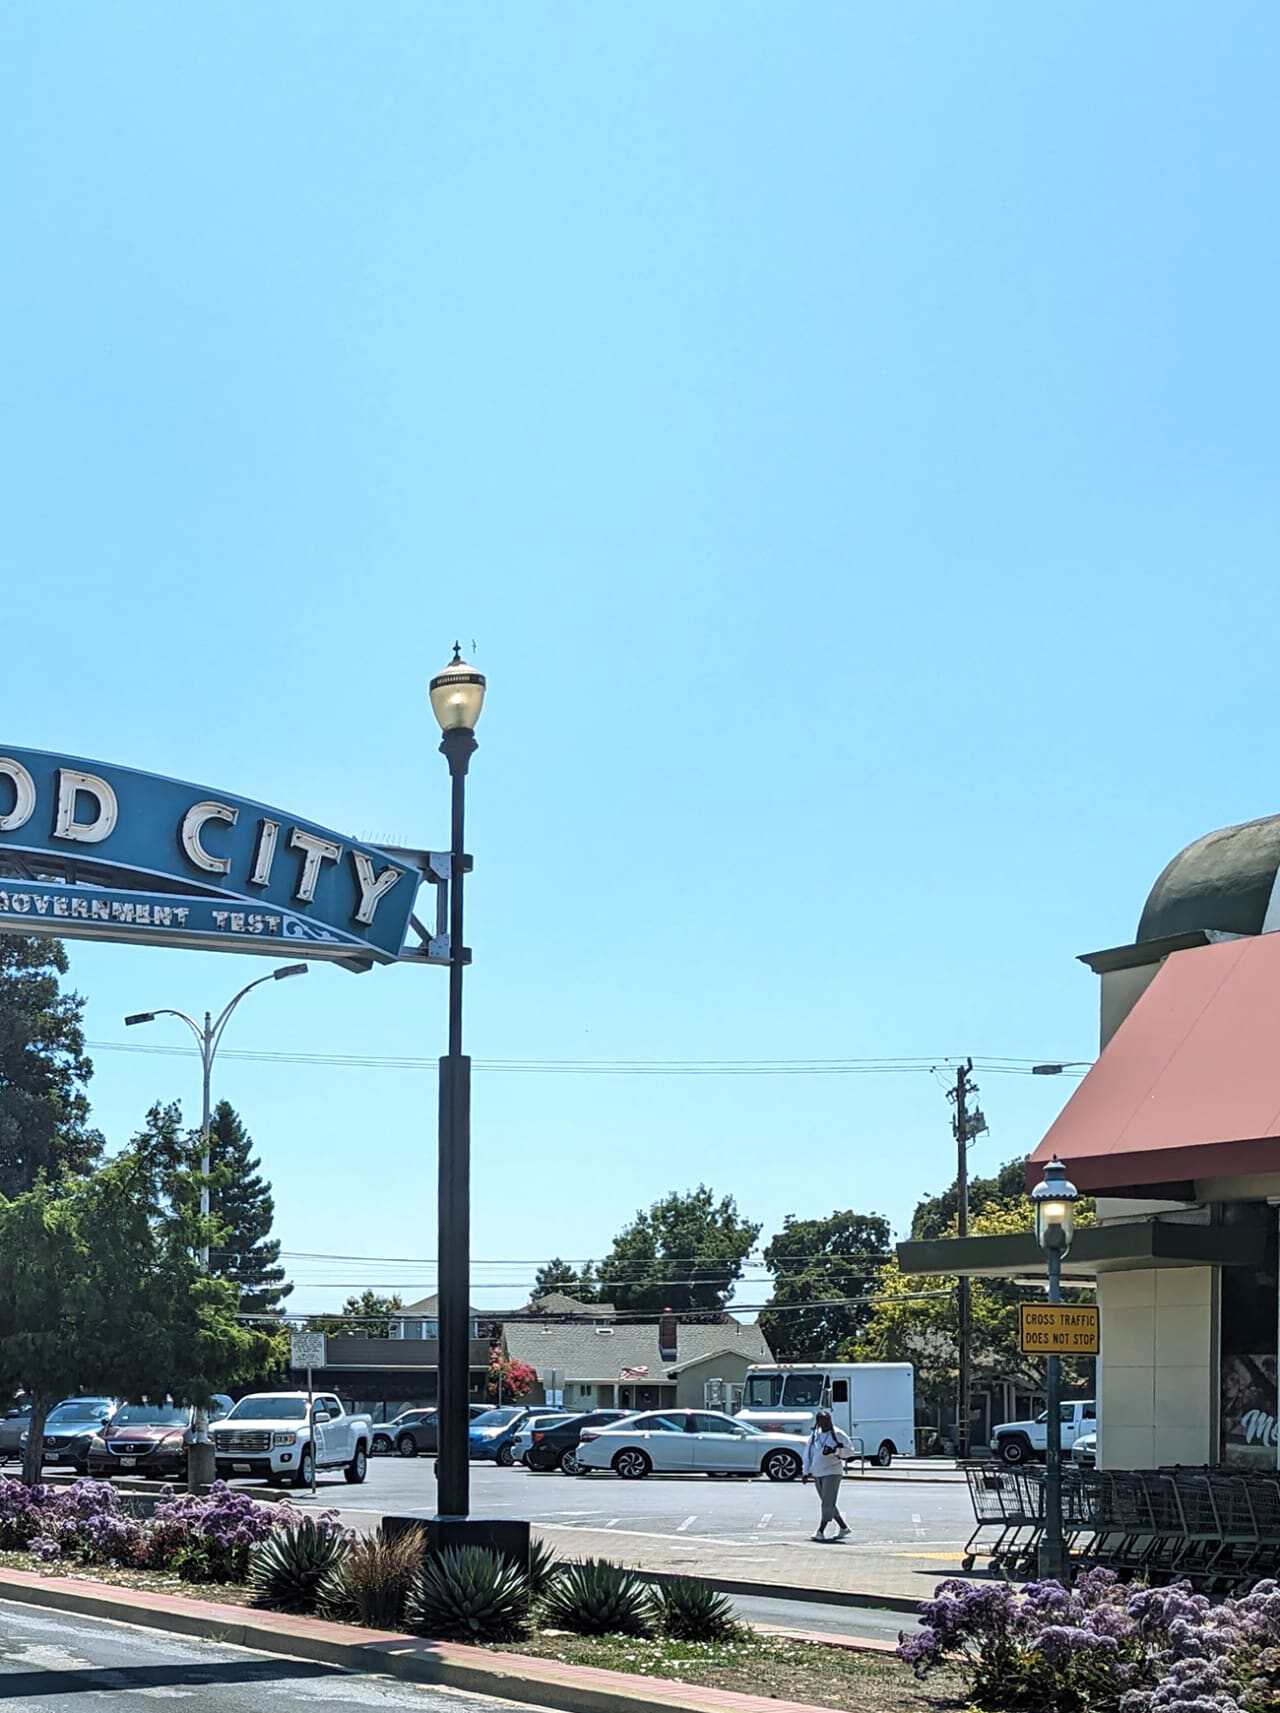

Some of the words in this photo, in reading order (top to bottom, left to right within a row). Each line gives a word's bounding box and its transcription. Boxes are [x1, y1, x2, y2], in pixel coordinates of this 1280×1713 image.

[181, 801, 405, 924] CITY
[212, 910, 281, 934] TEST
[1025, 1313, 1055, 1325] CROSS
[1060, 1314, 1095, 1326] TRAFFIC
[1025, 1332, 1049, 1344] DOES
[1053, 1332, 1069, 1344] NOT
[1073, 1333, 1095, 1345] STOP
